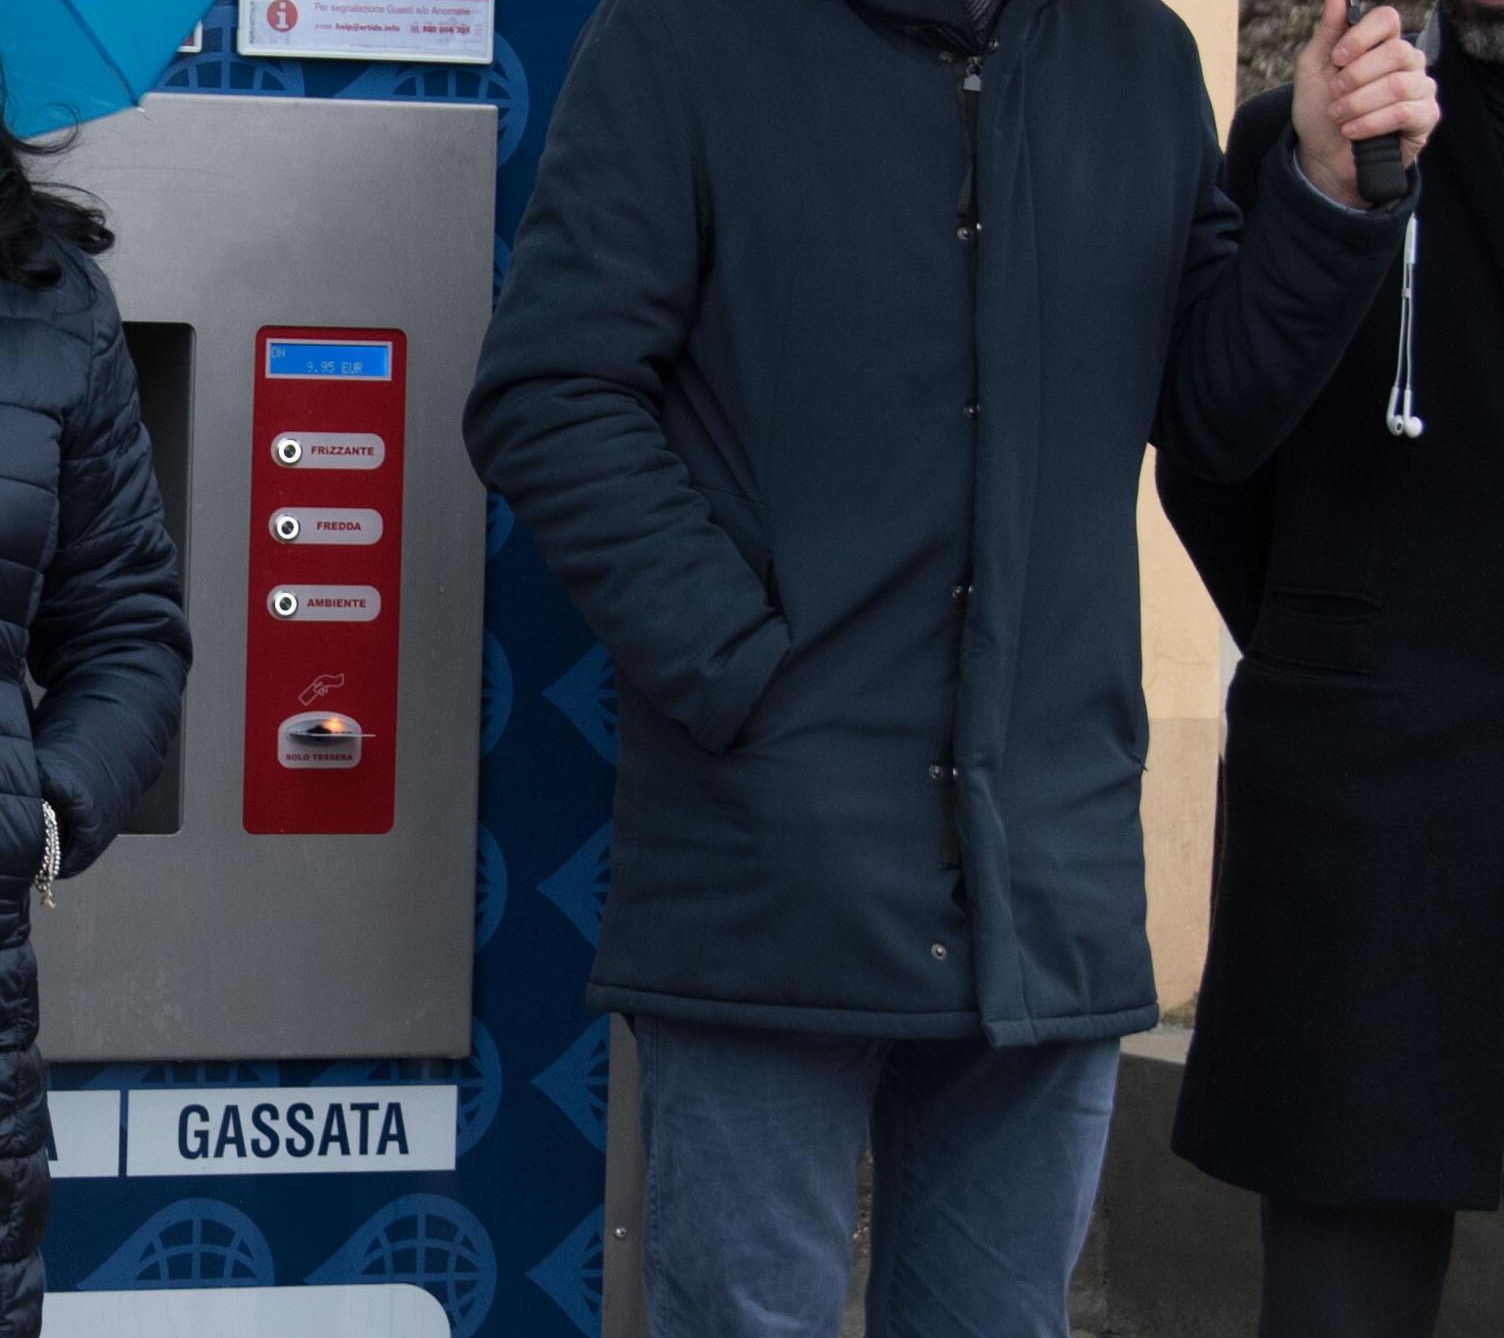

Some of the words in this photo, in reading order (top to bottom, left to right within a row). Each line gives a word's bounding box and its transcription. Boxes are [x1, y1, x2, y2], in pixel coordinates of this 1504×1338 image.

[306, 361, 335, 374] 9.95
[342, 362, 364, 374] EUR
[316, 521, 362, 532] FREDDA
[307, 598, 367, 609] AMBIENTE
[285, 753, 311, 761] SOLO
[311, 753, 353, 761] TESSERA
[177, 1101, 410, 1161] GASSATA
